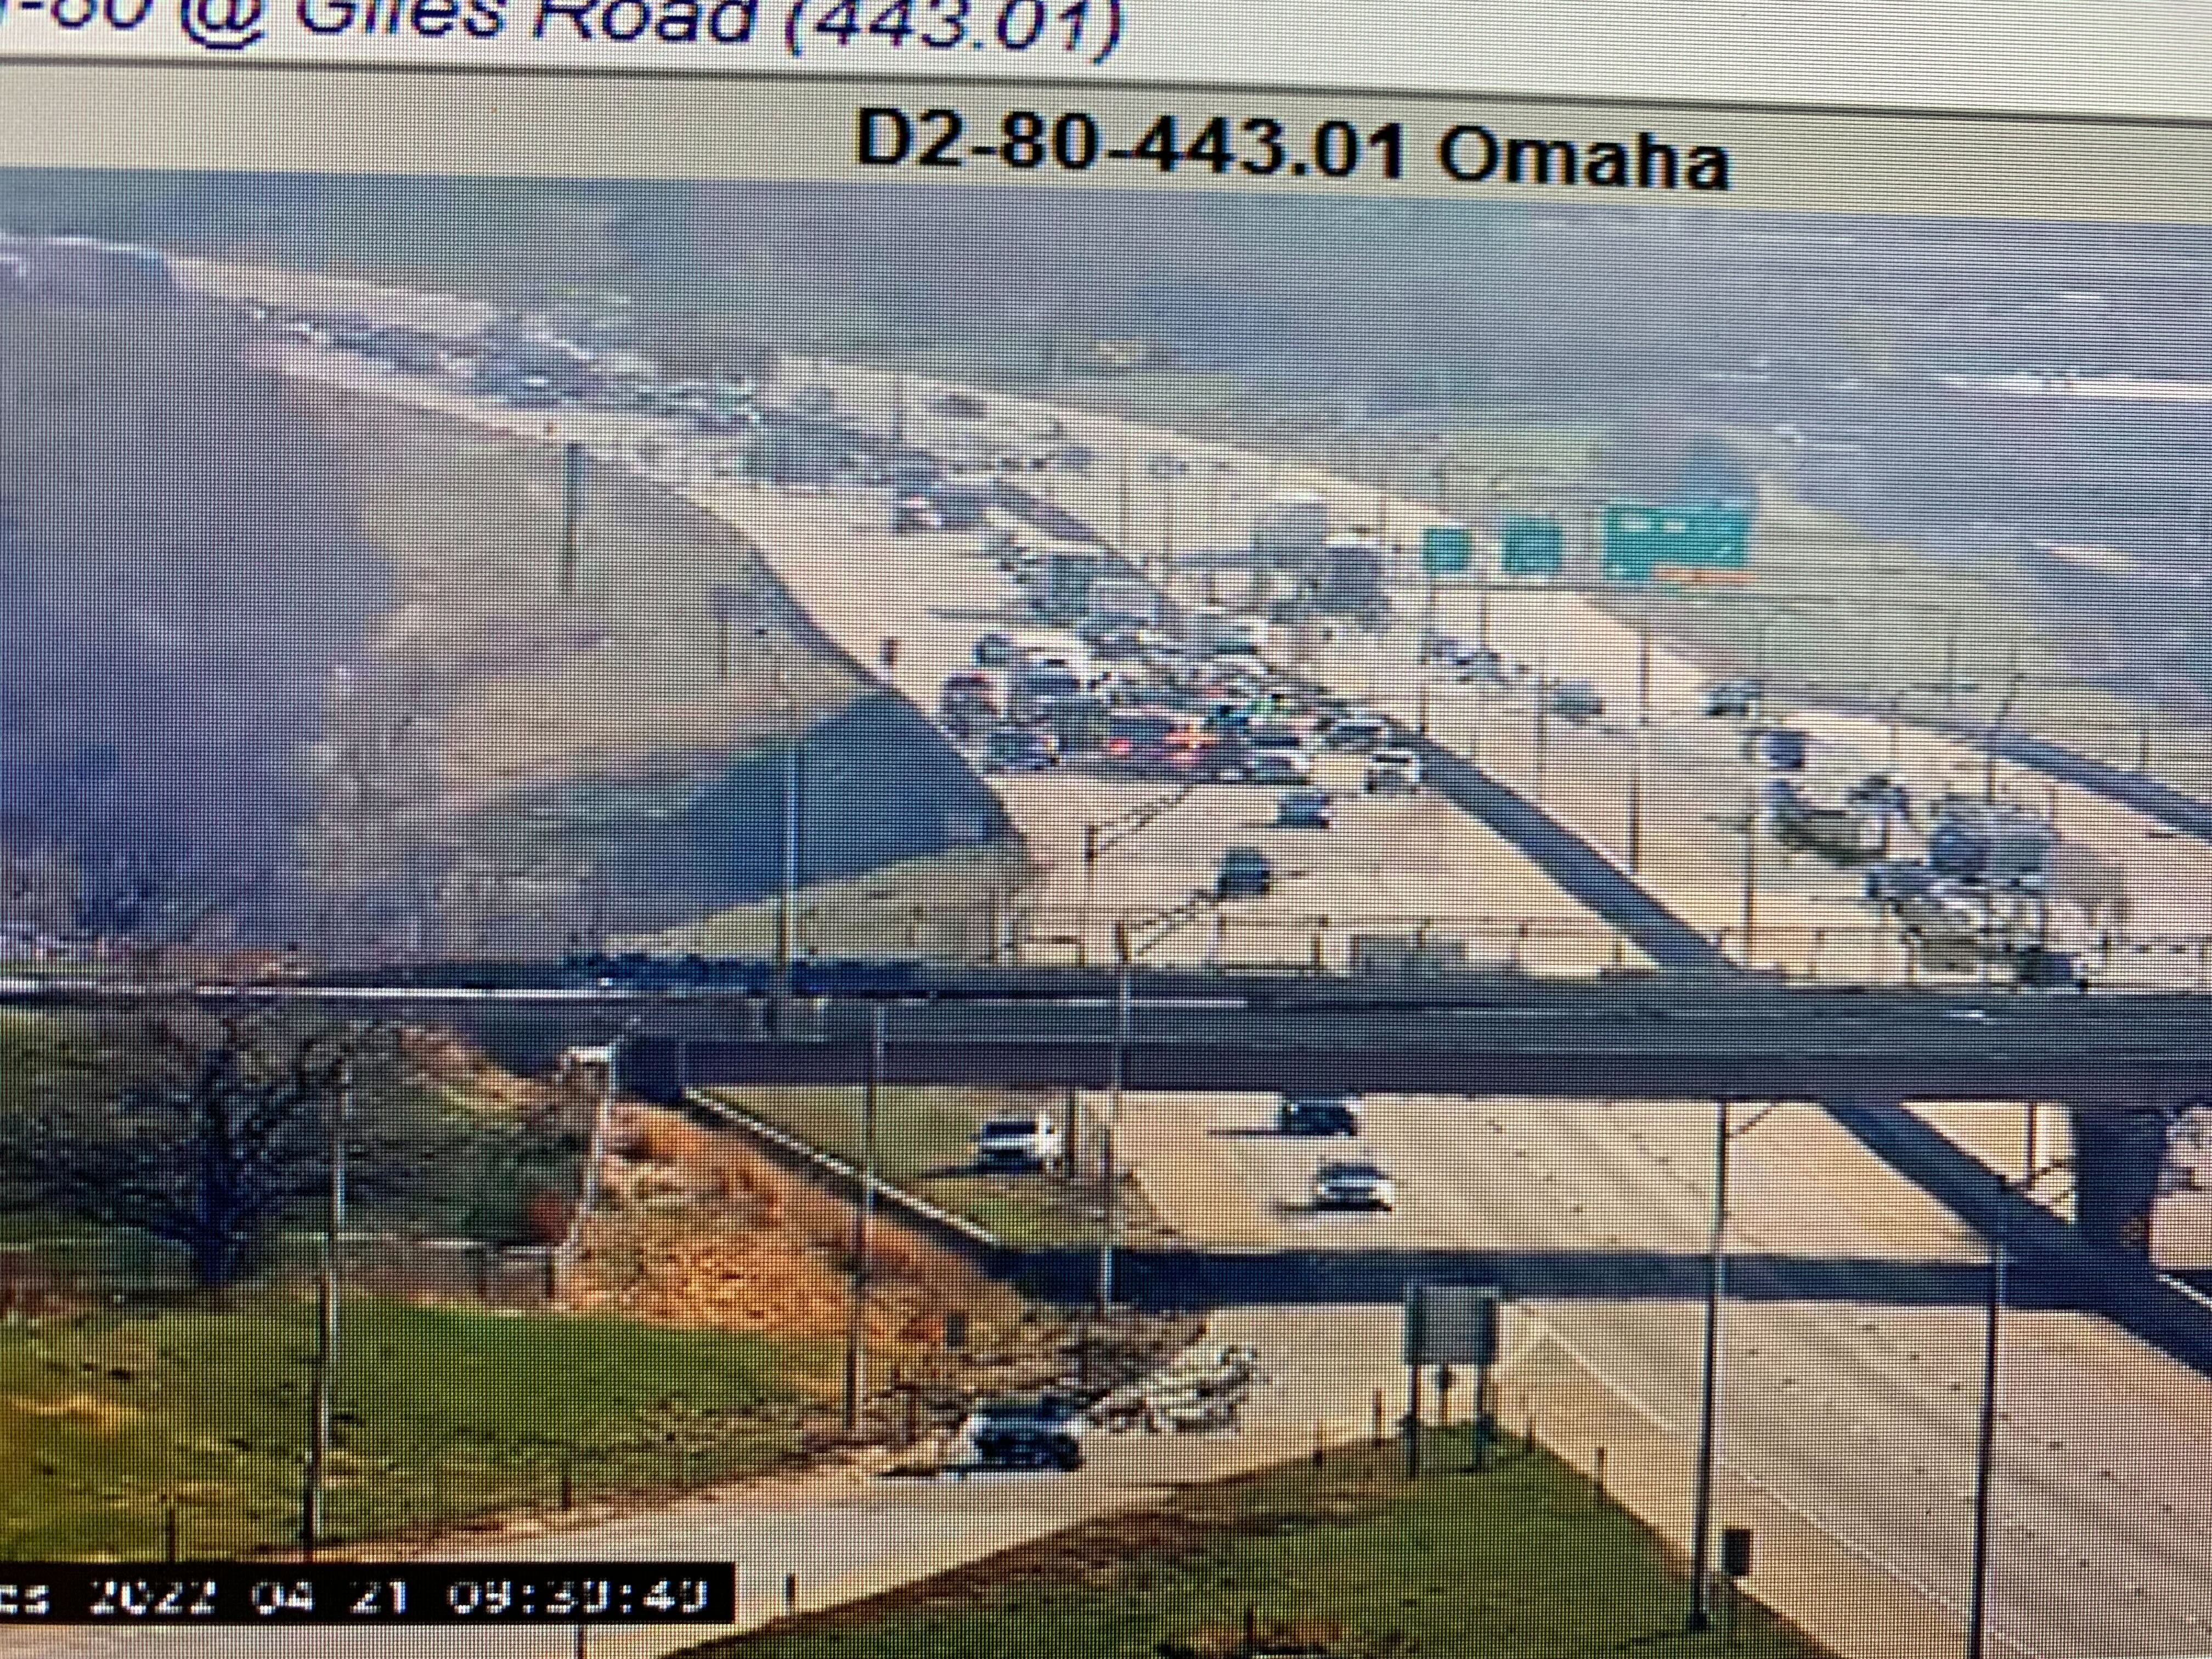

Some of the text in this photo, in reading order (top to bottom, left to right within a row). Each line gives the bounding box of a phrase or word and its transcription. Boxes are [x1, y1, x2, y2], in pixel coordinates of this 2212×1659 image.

[180, 0, 264, 49] @
[297, 0, 506, 38] Giles
[533, 0, 757, 42] Road
[786, 0, 1122, 63] (443.01)
[857, 107, 1731, 190] D2-80-443.01 Omaha
[89, 1579, 216, 1615] 2022
[251, 1580, 315, 1615] 04
[349, 1580, 407, 1614] 21
